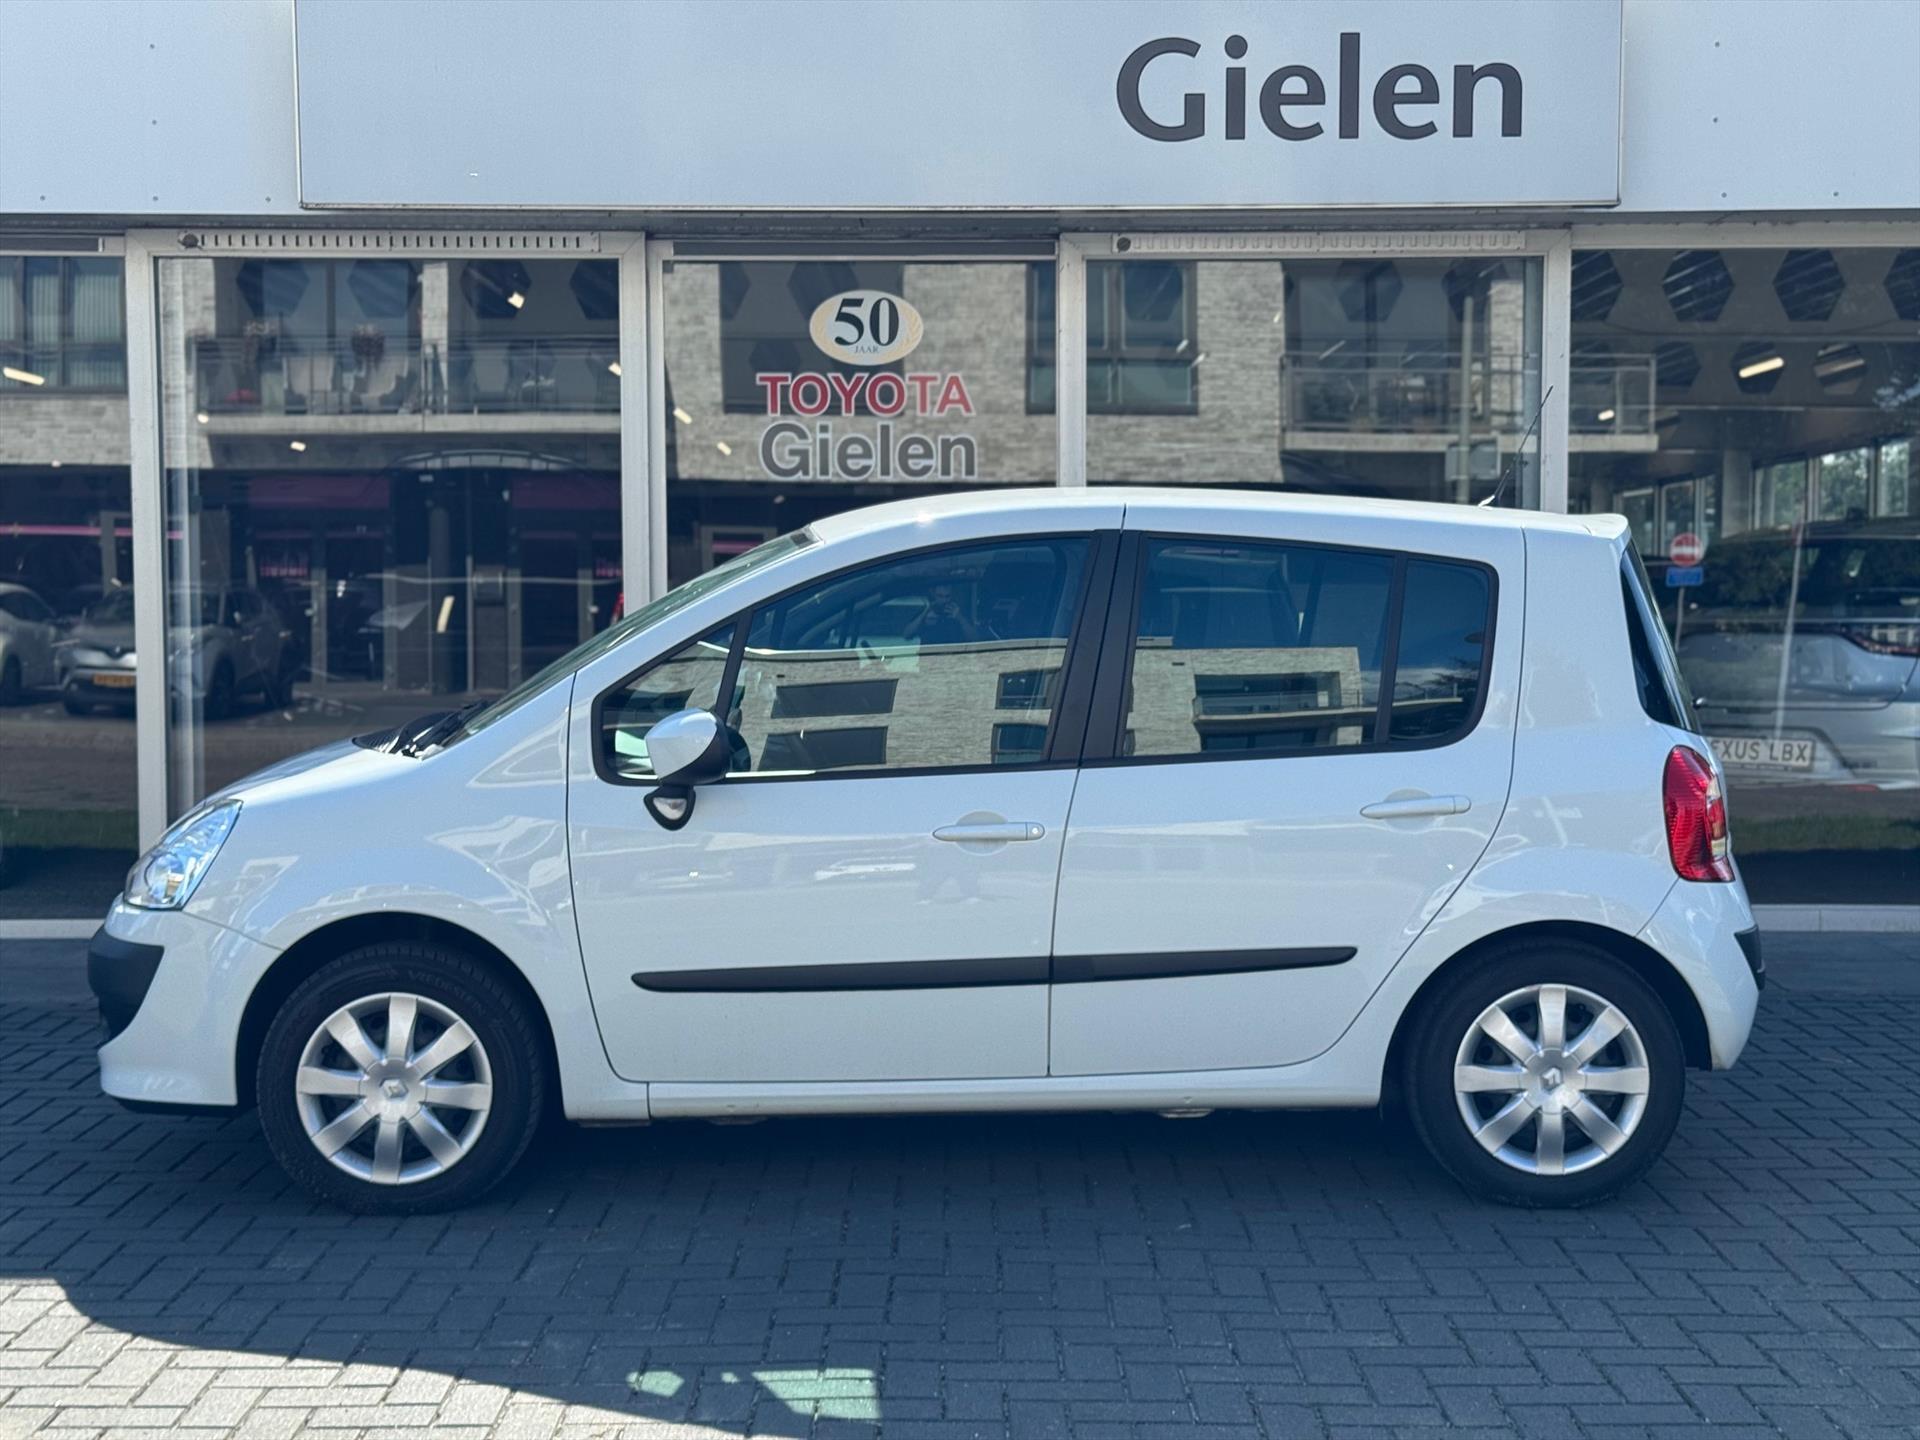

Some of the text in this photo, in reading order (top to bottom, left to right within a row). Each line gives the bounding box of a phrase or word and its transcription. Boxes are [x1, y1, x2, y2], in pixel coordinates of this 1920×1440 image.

[1115, 31, 1523, 142] Gielen
[834, 296, 900, 346] 50
[853, 345, 880, 354] JAAR
[756, 373, 975, 416] TOYOTA
[760, 420, 978, 480] Gielen
[1769, 743, 1808, 763] LBX
